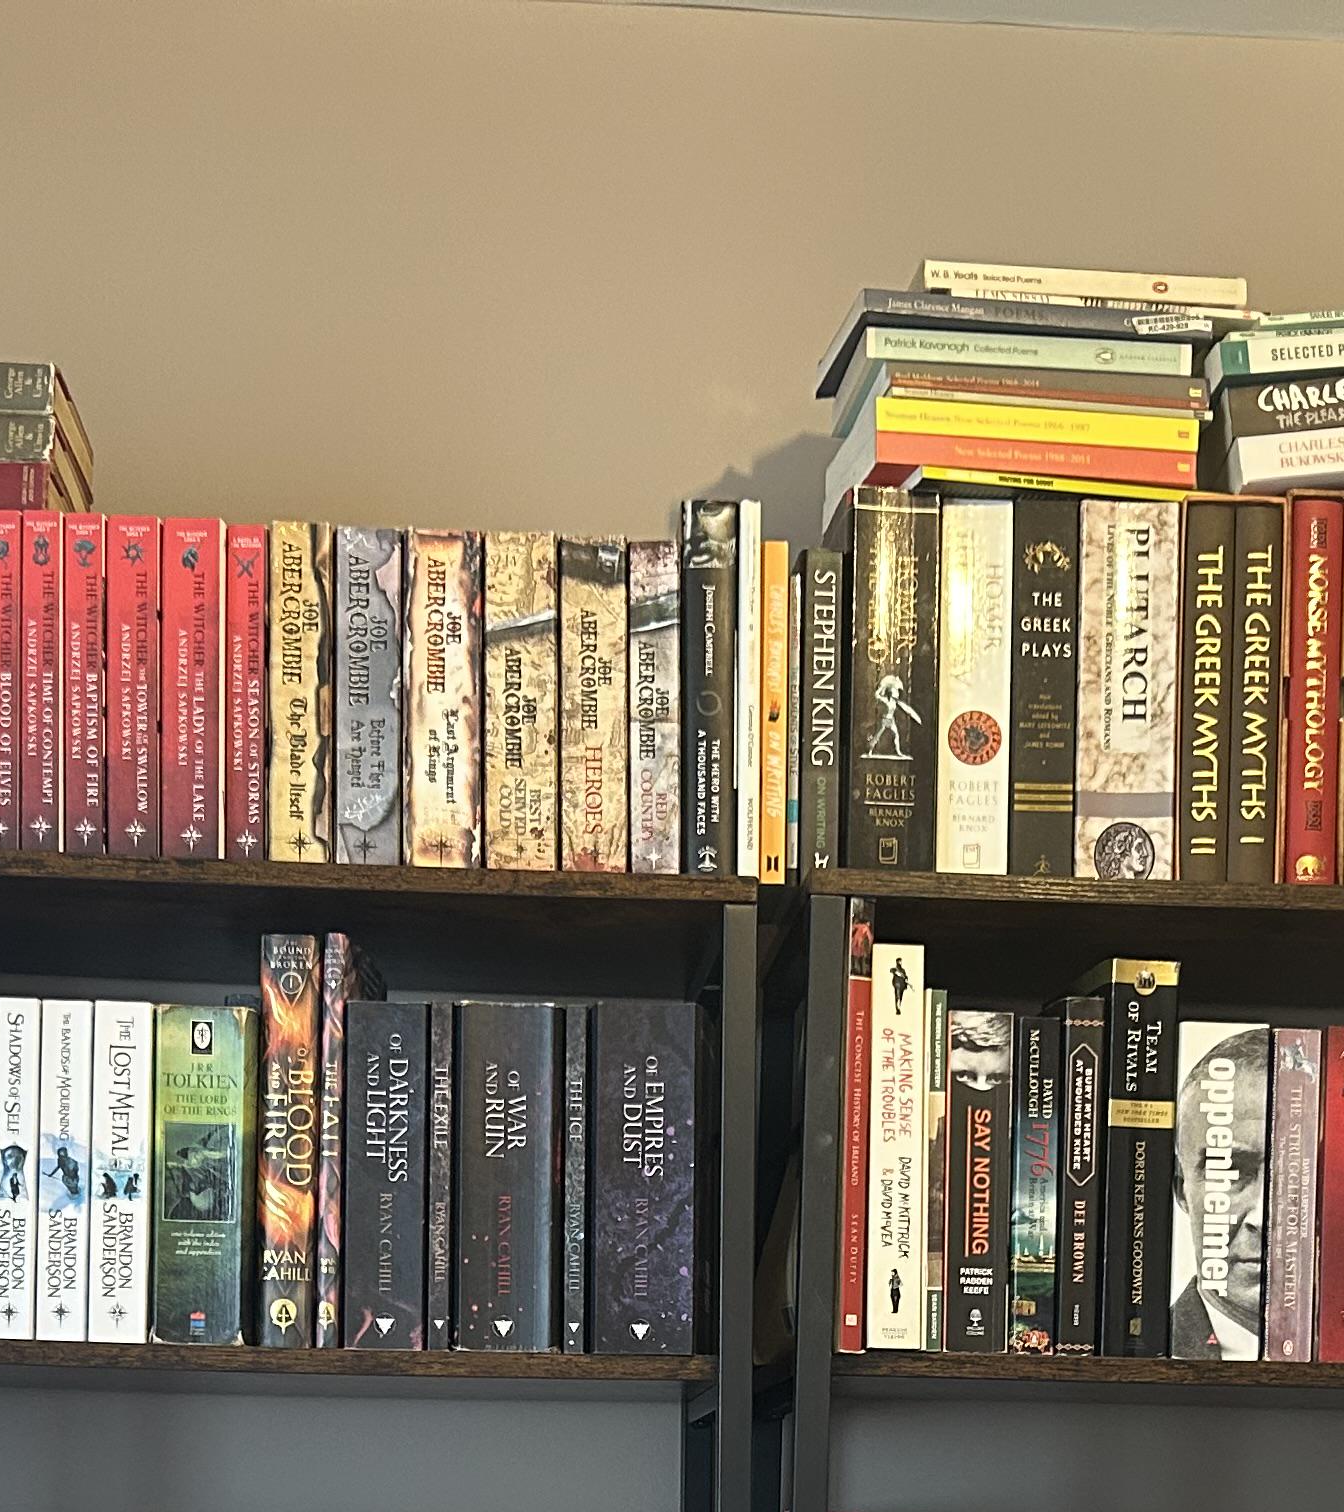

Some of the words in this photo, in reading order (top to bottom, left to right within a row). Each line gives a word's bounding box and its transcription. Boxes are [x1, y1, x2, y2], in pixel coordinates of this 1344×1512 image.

[884, 337, 916, 350] Patrick
[918, 340, 969, 353] Kavanagh
[1271, 346, 1332, 361] SELECTED
[1276, 413, 1304, 430] THE
[1032, 592, 1062, 607] THE
[1196, 546, 1224, 607] THE
[282, 543, 301, 686] ABERCROMBIE
[304, 601, 319, 632] JOE
[814, 570, 837, 691] STEPHEN
[1021, 616, 1070, 632] GREEK
[1121, 527, 1151, 723] PLUTARCH
[1022, 642, 1071, 658] PLAYS
[1193, 615, 1223, 707] GREEK
[809, 700, 835, 767] KING
[1191, 714, 1220, 822] MYTHS
[1190, 839, 1216, 855] II
[1128, 1002, 1139, 1025] OF
[389, 1033, 402, 1056] OF
[1125, 1029, 1140, 1093] RIVALS
[1144, 1021, 1163, 1074] TEAM
[165, 1074, 237, 1088] TOLKIEN
[367, 1053, 381, 1086] AND
[366, 1091, 386, 1163] LIGHT
[388, 1059, 408, 1182] DARKNESS
[971, 1108, 992, 1151] SAY
[1199, 1056, 1240, 1297] oppenheimer
[970, 1153, 991, 1255] NOTHING
